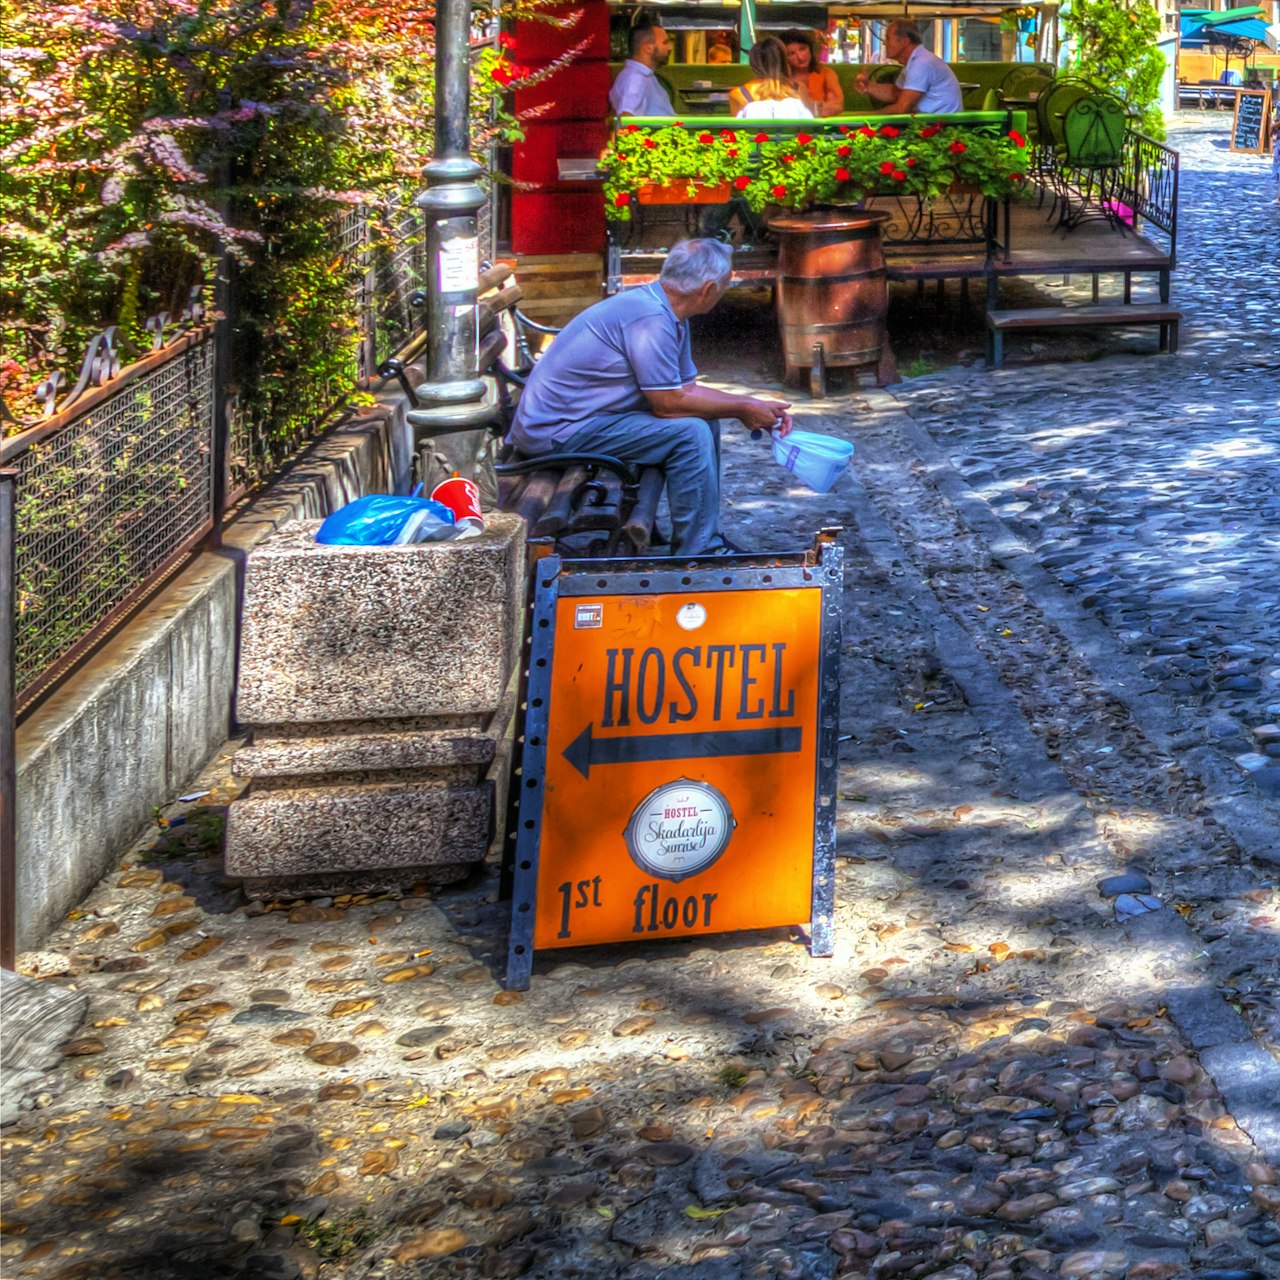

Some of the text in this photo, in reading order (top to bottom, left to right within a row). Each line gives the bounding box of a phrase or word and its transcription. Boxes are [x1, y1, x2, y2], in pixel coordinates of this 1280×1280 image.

[601, 642, 796, 728] HOSTEL
[663, 806, 699, 819] HOSTEL
[644, 818, 716, 849] Skadarlija
[657, 838, 703, 857] Sunrise
[556, 874, 718, 939] 1st floor
